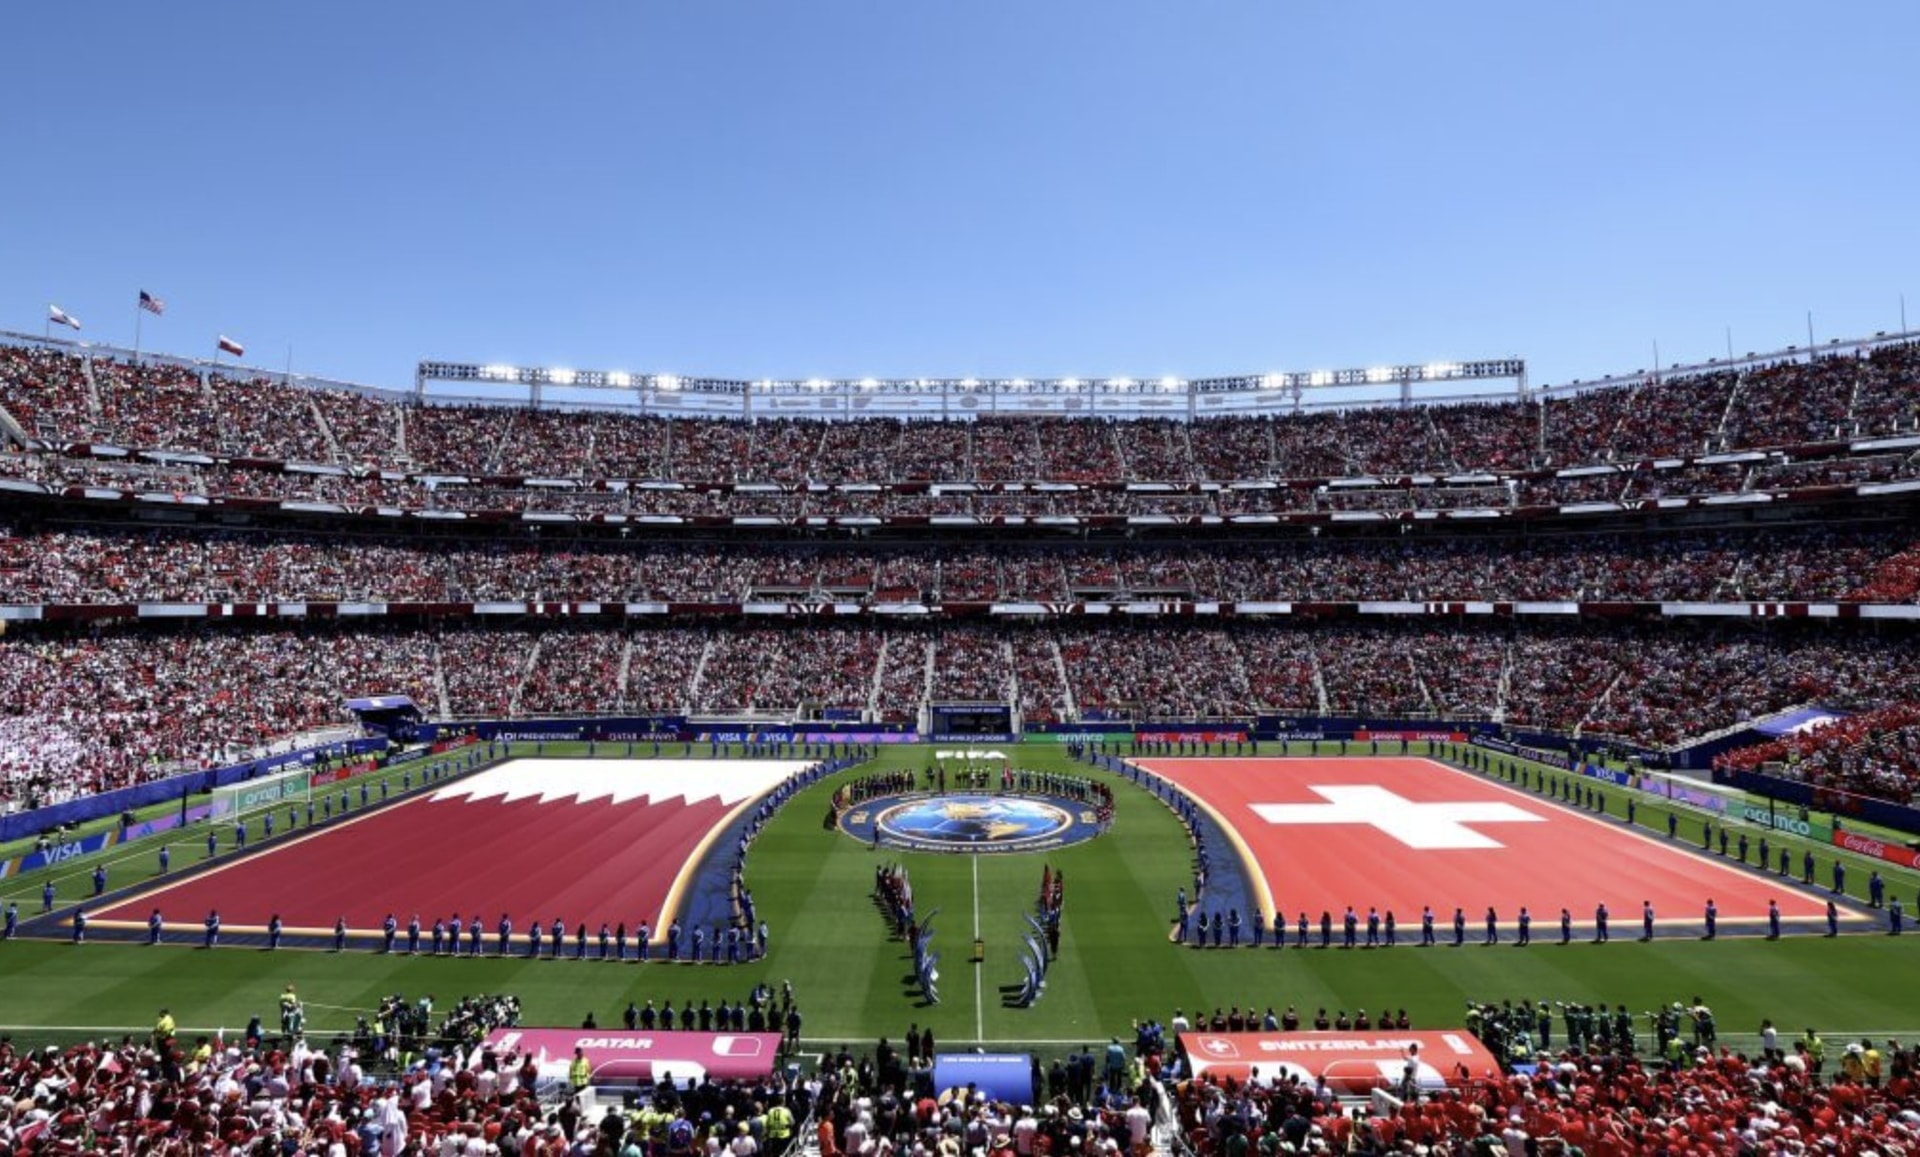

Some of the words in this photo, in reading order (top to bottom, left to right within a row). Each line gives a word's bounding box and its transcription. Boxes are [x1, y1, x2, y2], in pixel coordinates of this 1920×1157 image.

[609, 733, 637, 741] QATAR
[717, 732, 741, 741] VISA
[764, 732, 787, 741] VISA
[1056, 732, 1105, 742] aramco
[935, 750, 1008, 759] FIFA
[1595, 766, 1616, 782] VISA
[41, 841, 82, 864] VISA
[575, 1037, 653, 1049] QATAR
[1259, 1040, 1425, 1051] SWITZERLAND
